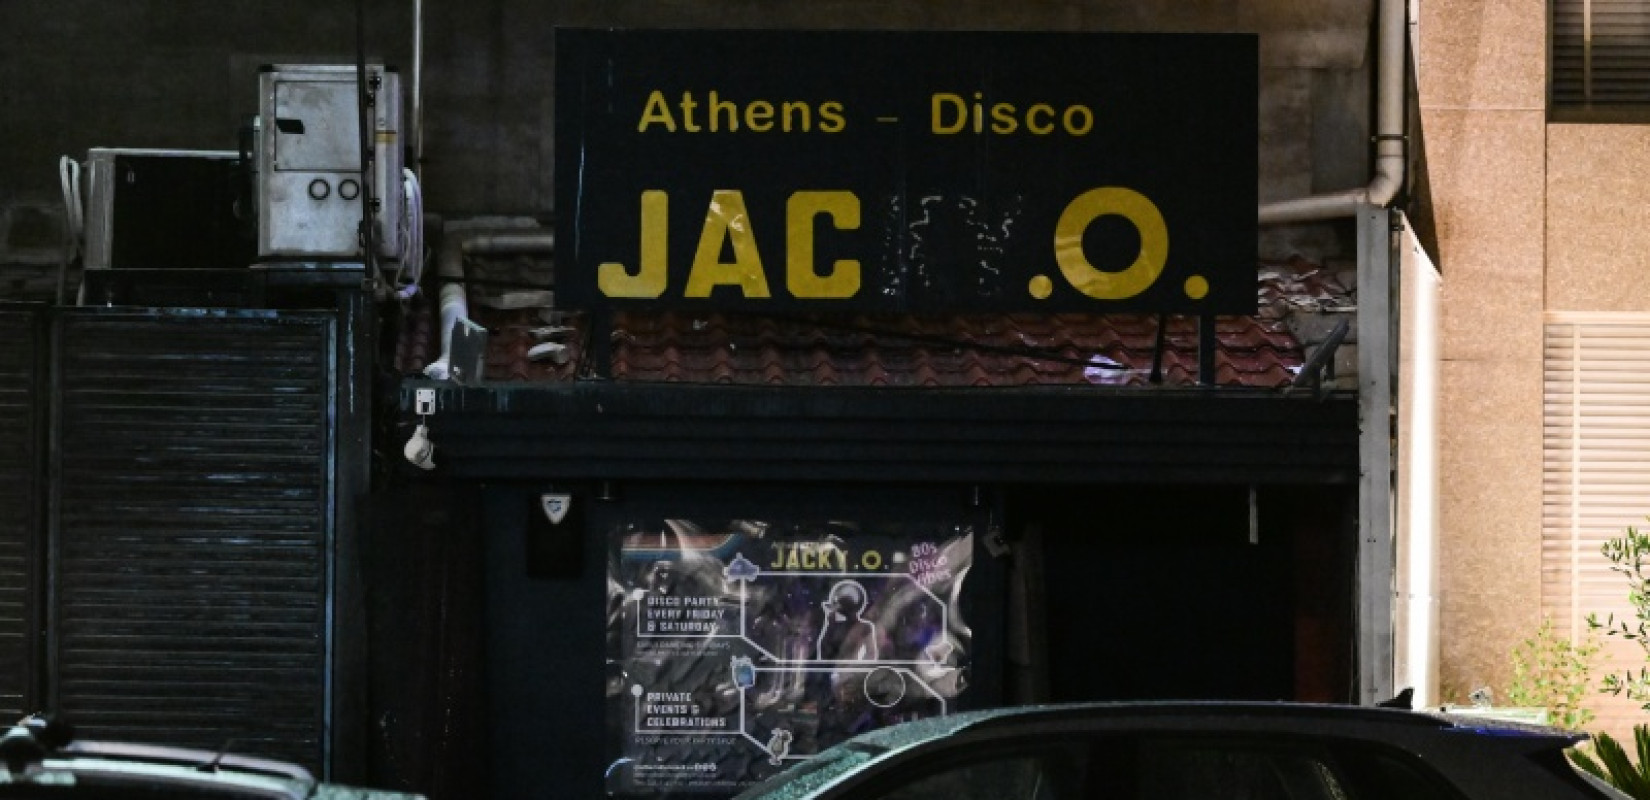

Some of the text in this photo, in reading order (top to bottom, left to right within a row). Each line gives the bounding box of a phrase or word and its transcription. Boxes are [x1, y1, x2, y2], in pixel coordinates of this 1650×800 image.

[638, 90, 847, 134] Athens
[930, 92, 1096, 135] Disco
[647, 597, 719, 606] DISCO PARTY
[647, 609, 725, 620] EVERY FRIDAY
[660, 622, 718, 633] SATURDAY
[647, 692, 692, 702] PRIVATE
[647, 704, 688, 714] EVENTS
[647, 717, 726, 728] CELEBRATIONS
